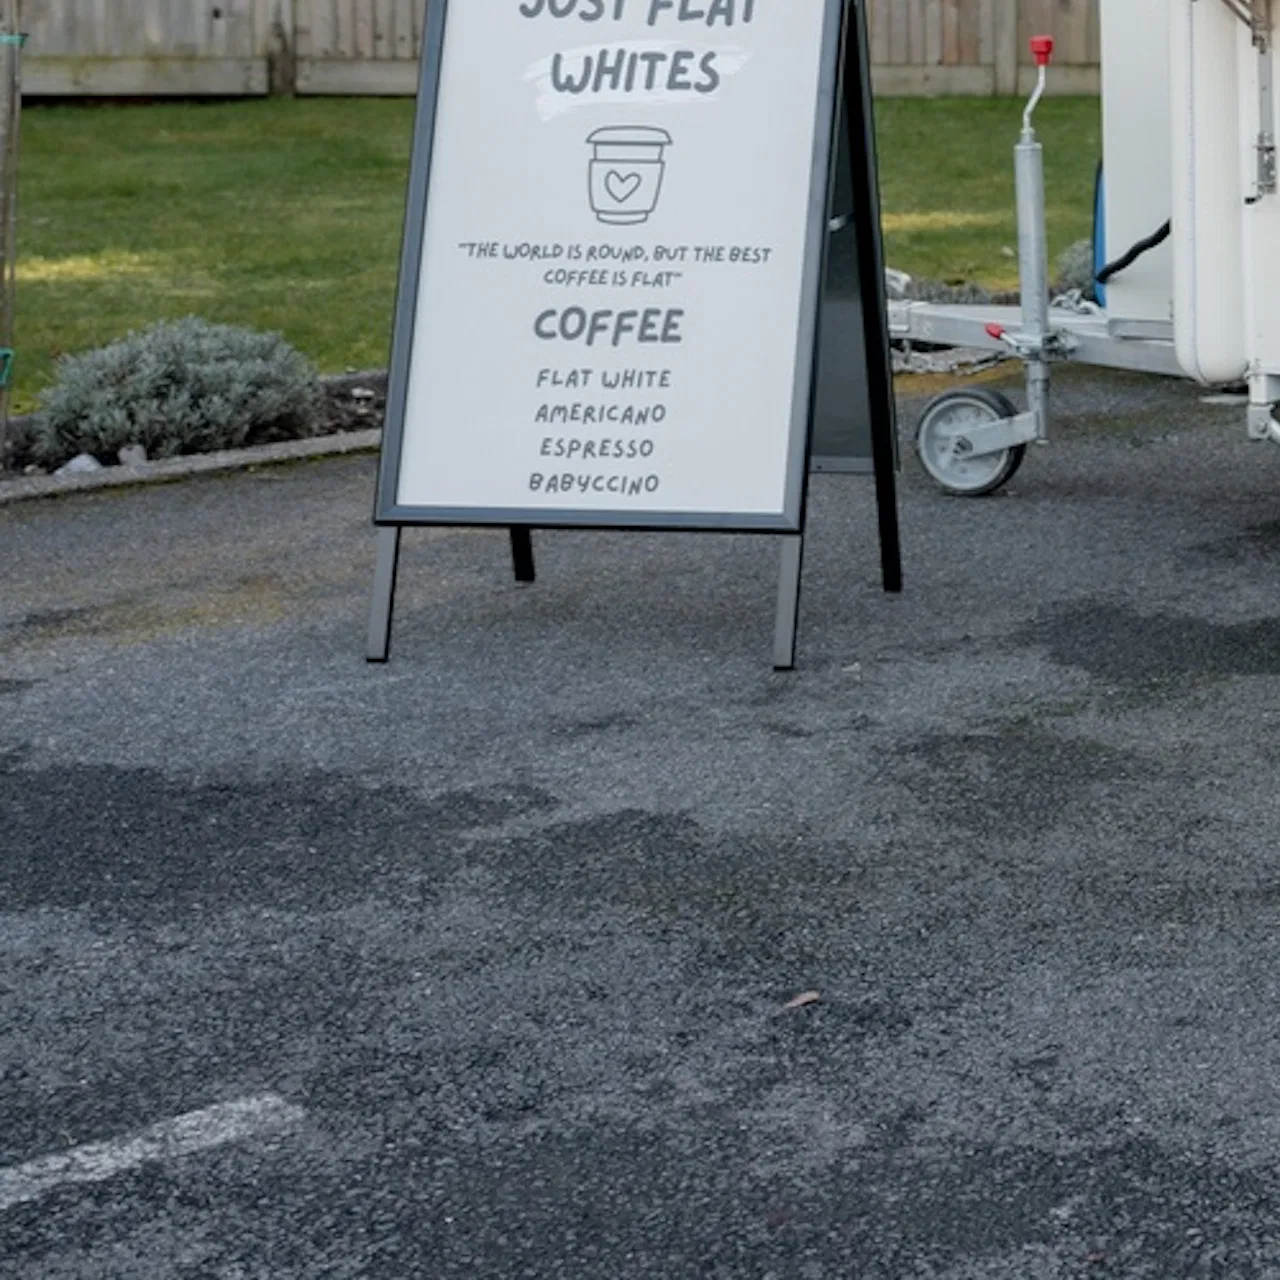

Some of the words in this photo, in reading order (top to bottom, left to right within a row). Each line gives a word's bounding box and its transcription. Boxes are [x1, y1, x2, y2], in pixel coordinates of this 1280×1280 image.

[551, 49, 720, 94] WHITES
[502, 242, 564, 261] WORLD
[567, 242, 582, 261] IS
[586, 242, 649, 264] ROUND,
[653, 244, 688, 262] BUT
[693, 245, 726, 263] THE
[728, 245, 772, 264] BEST
[543, 268, 608, 287] COFFEE
[611, 270, 628, 287] IS
[534, 306, 684, 347] COFFEE
[536, 368, 592, 388] FLAT
[601, 369, 672, 390] WHITE
[534, 403, 666, 425] AMERICANO
[539, 437, 654, 459] ESPRESSO
[528, 472, 660, 496] BABYCCINO
